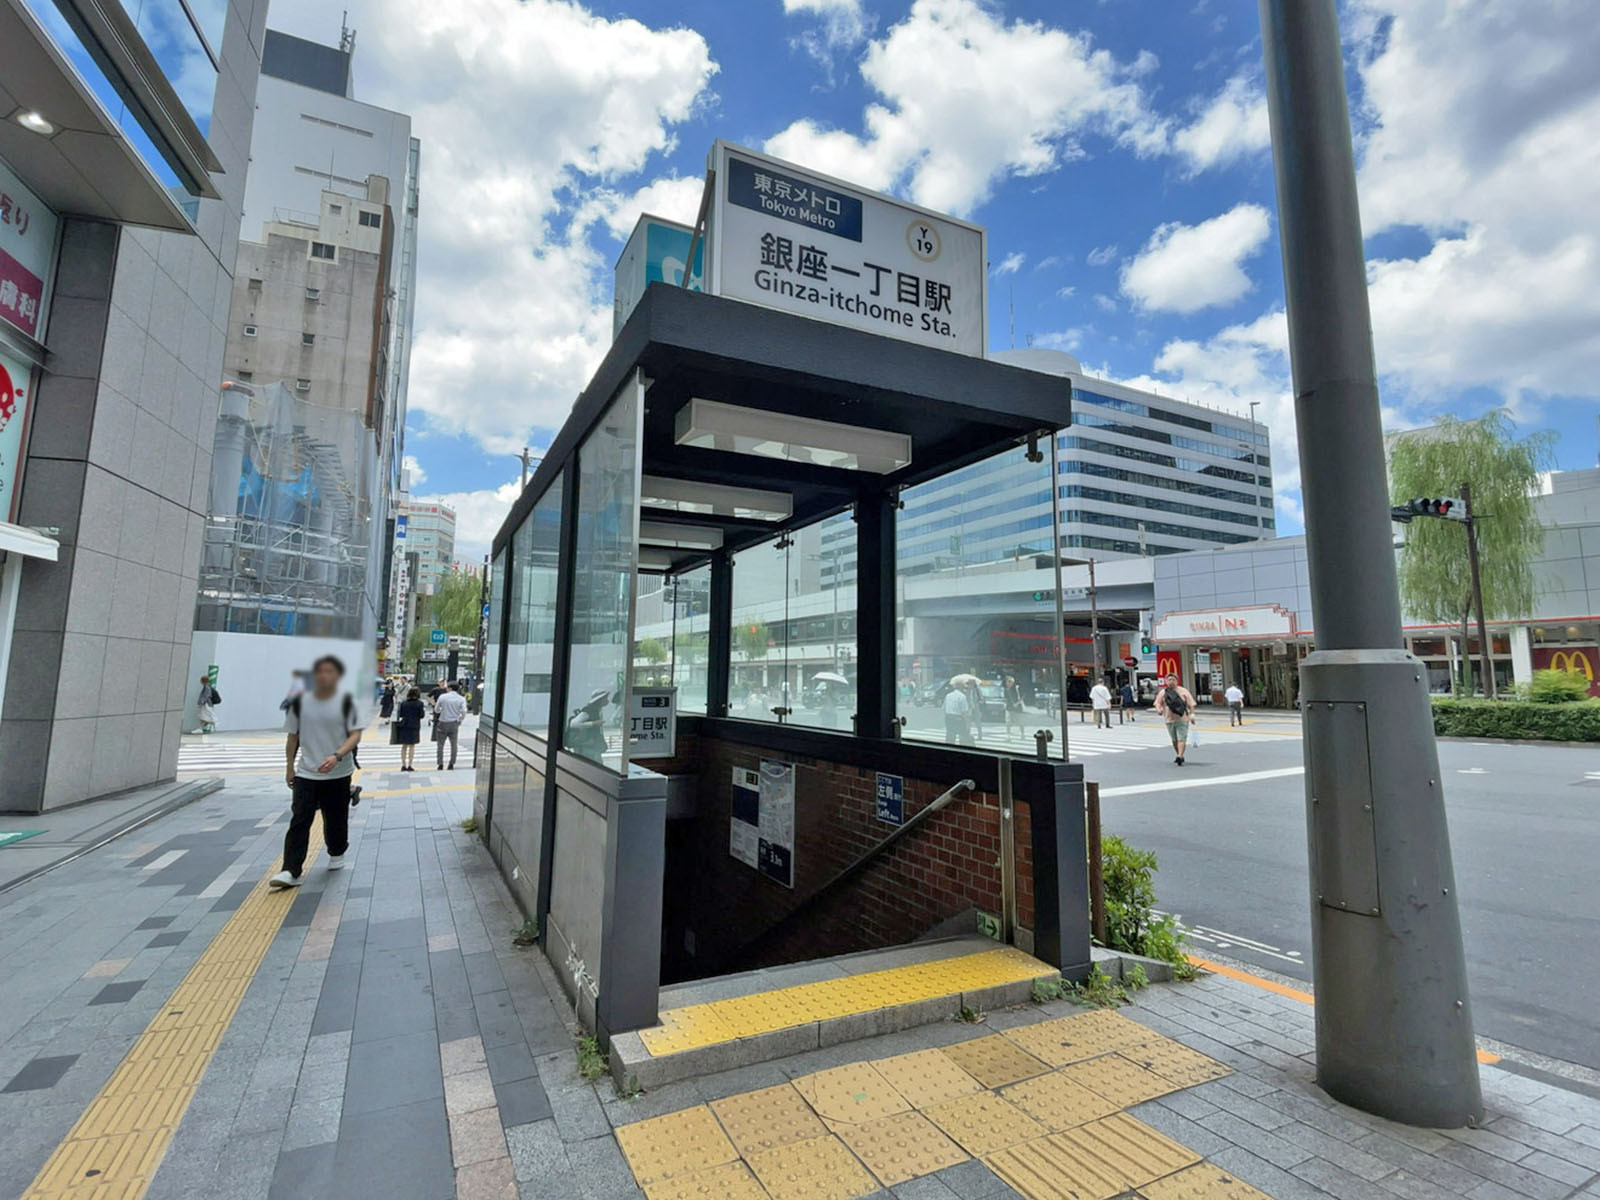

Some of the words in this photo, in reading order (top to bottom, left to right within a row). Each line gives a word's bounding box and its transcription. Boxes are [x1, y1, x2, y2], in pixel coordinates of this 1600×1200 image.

[754, 173, 841, 215] 東京メトロ
[759, 194, 797, 218] Tokyo
[799, 207, 836, 230] Metro
[916, 238, 933, 255] 19
[919, 226, 928, 240] Y
[759, 231, 952, 316] 銀座一丁目駅
[754, 268, 914, 328] Ginza-itchome
[920, 312, 957, 339] Sta.
